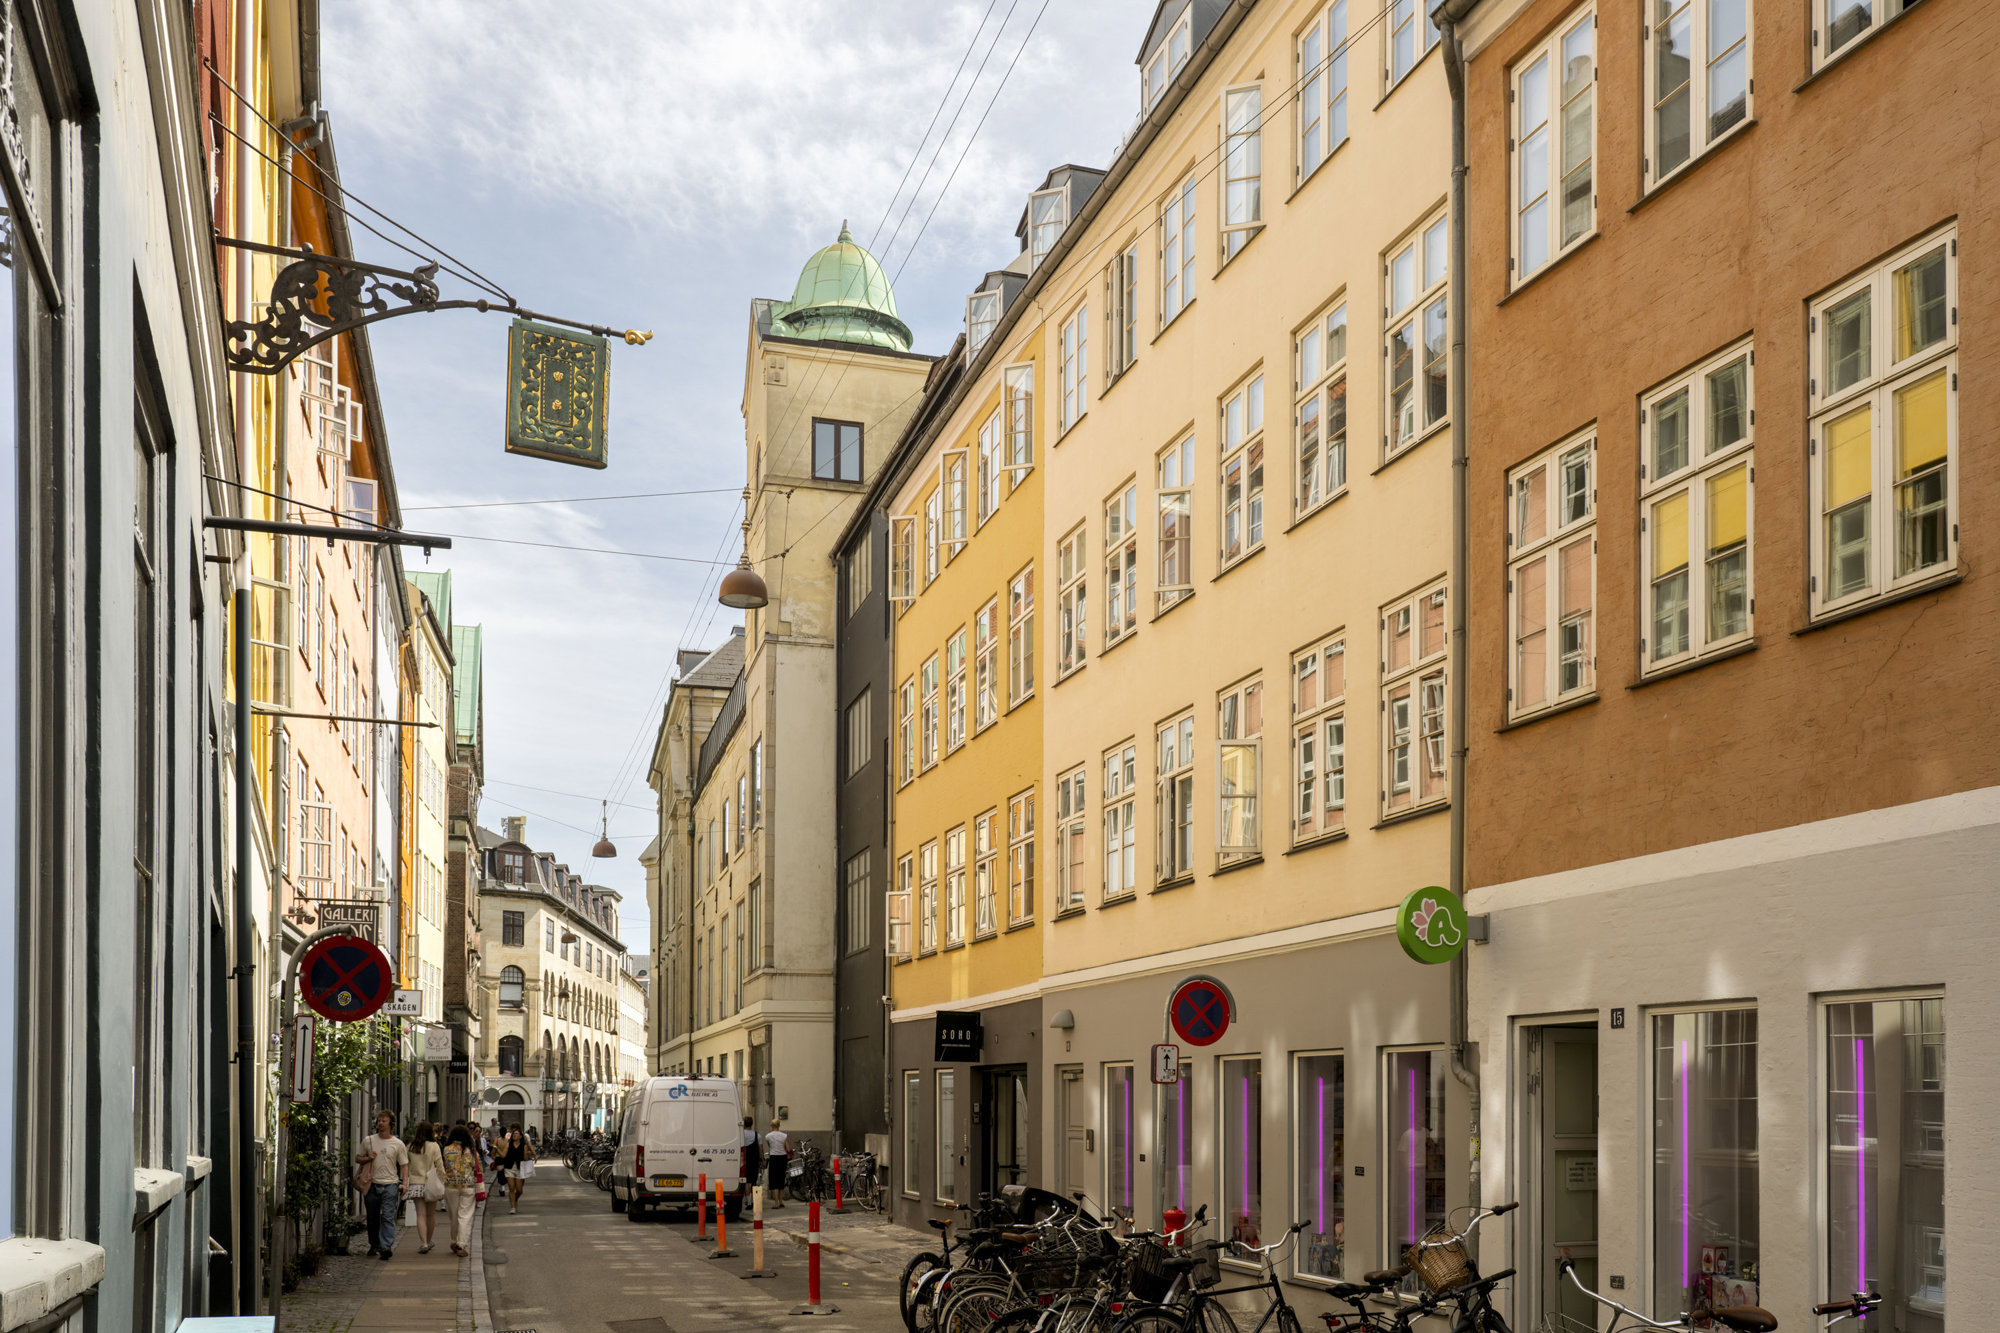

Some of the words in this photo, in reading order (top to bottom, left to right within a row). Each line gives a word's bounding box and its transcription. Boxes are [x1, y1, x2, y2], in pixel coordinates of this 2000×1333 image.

[323, 907, 373, 921] GALLERI
[1613, 1011, 1623, 1025] 15
[942, 1029, 971, 1040] SOHO
